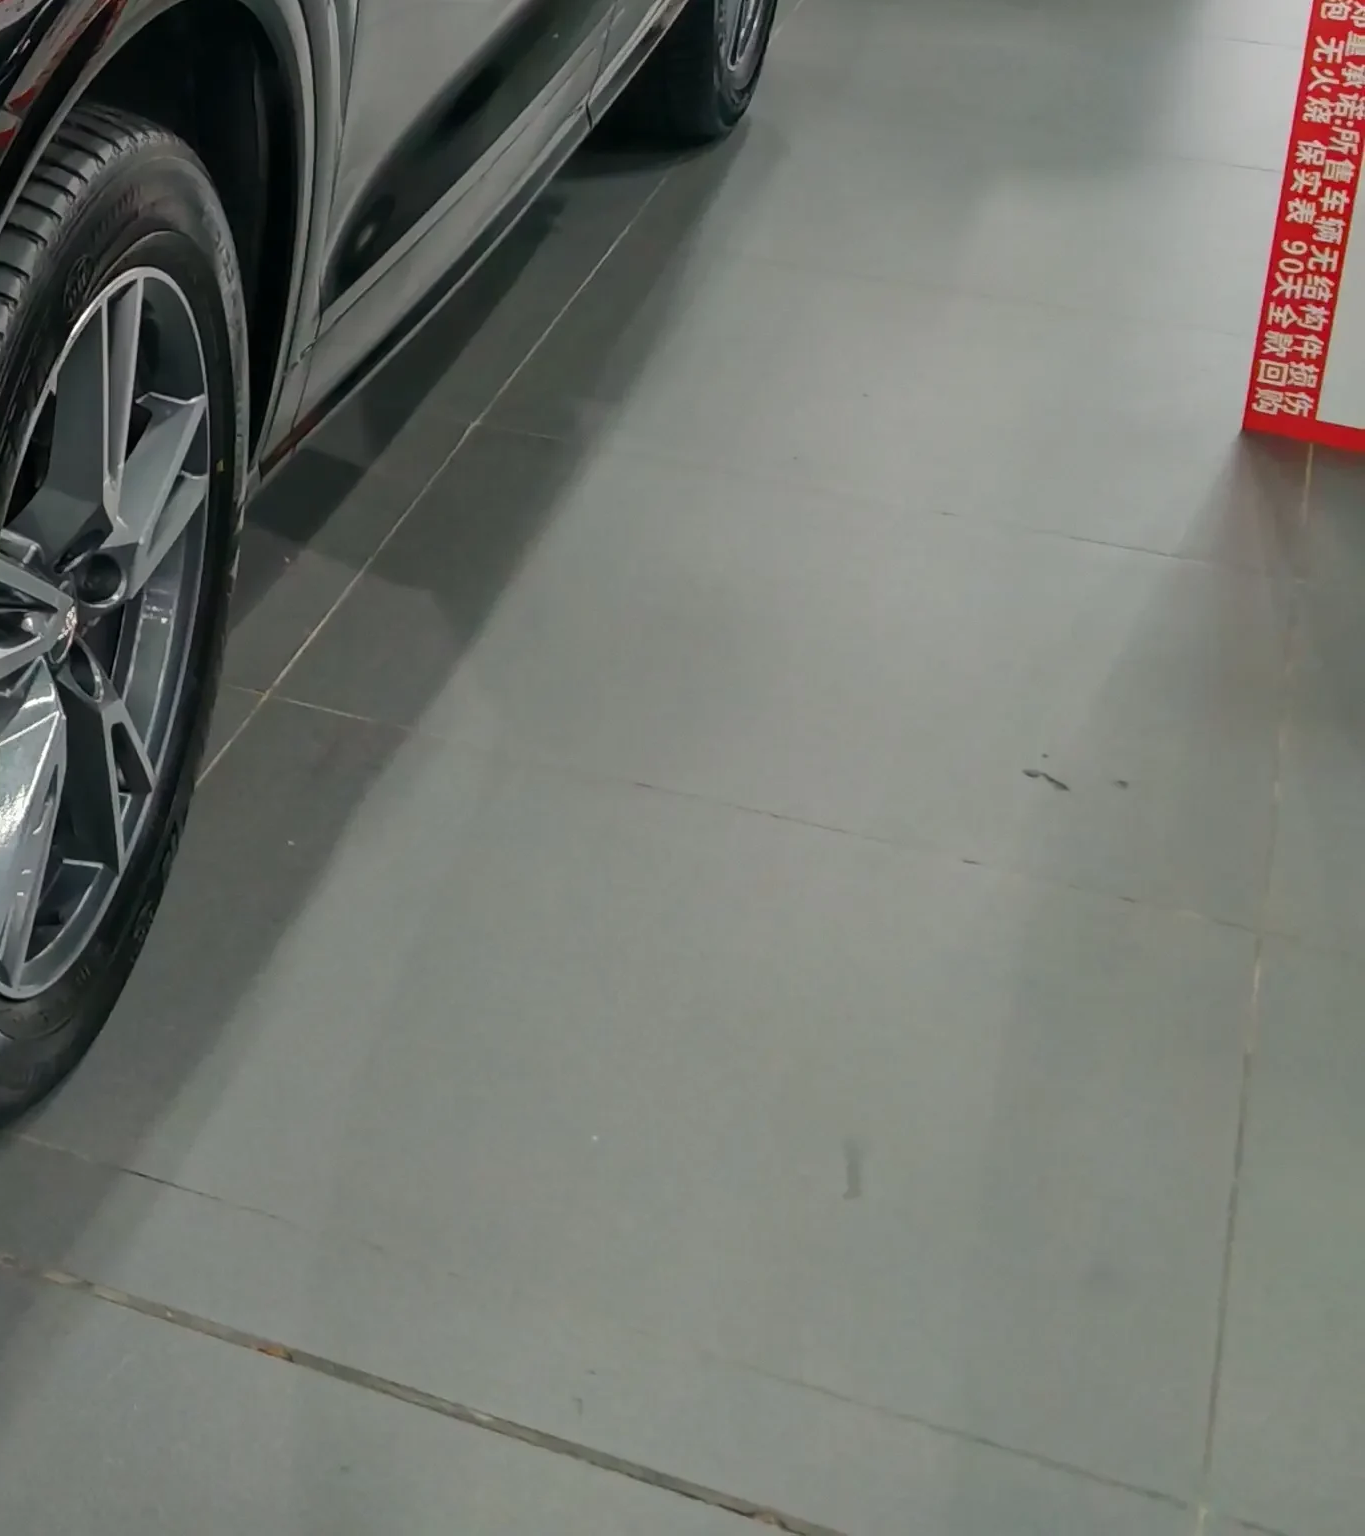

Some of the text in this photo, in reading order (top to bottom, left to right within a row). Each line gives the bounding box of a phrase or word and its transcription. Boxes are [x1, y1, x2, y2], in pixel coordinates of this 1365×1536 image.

[1302, 34, 1345, 124] 无火烧
[1284, 139, 1327, 225] 保实表
[1252, 239, 1309, 416] 90天全款回购
